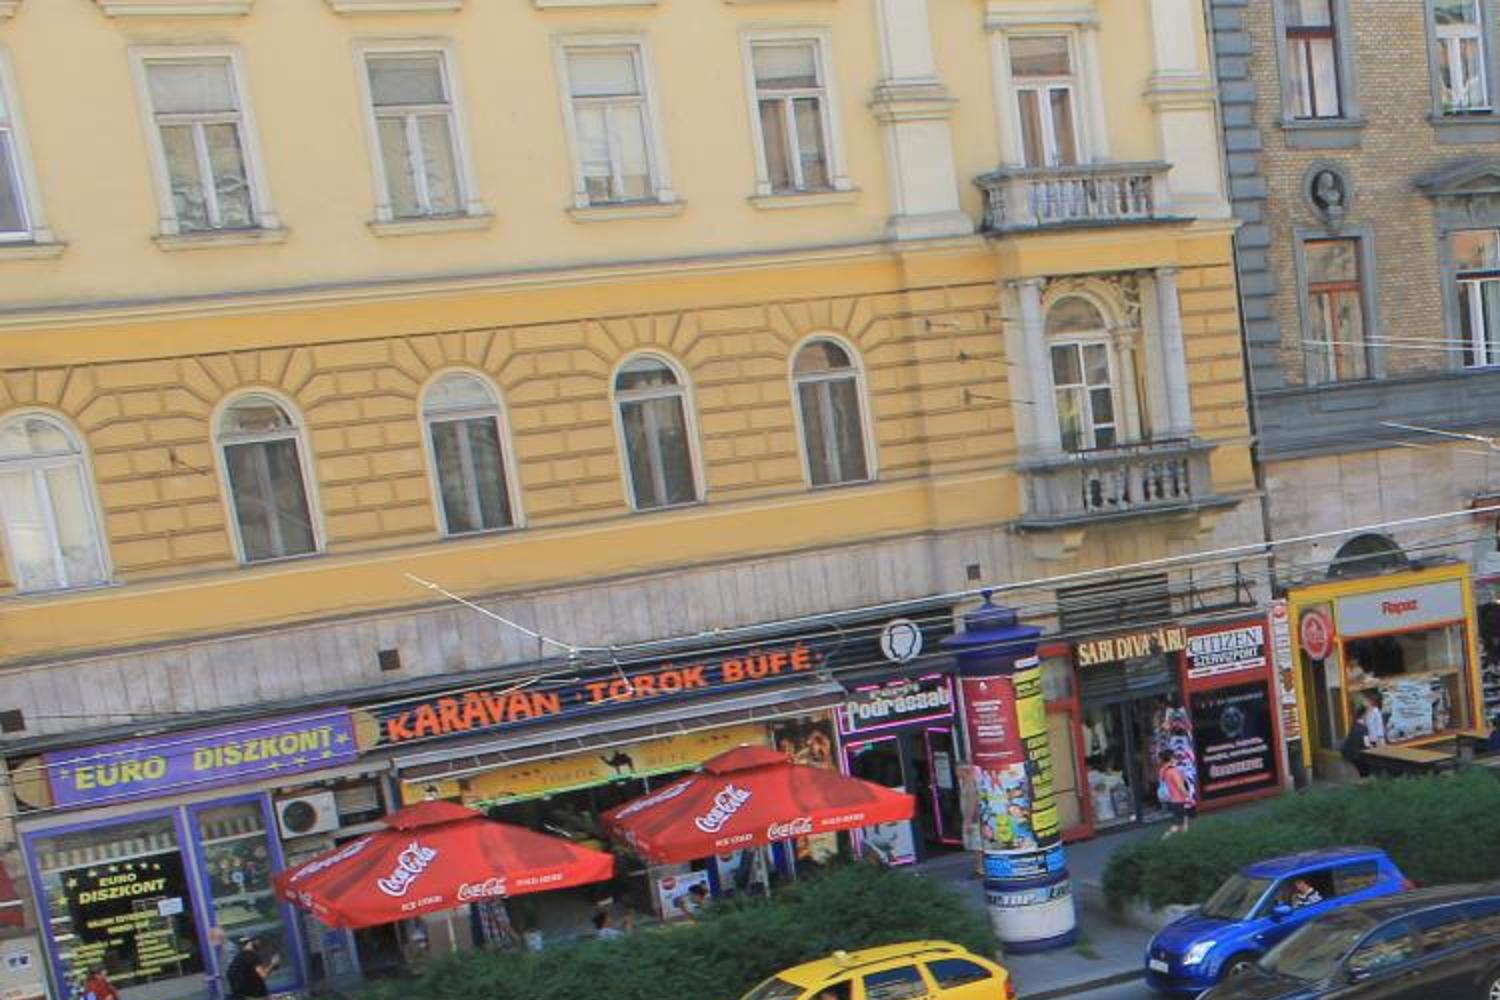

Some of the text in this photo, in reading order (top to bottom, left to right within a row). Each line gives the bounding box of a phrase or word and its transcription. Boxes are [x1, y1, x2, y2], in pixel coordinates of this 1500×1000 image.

[1078, 637, 1115, 667] SABI
[1190, 627, 1263, 654] CITIZEN
[585, 662, 708, 704] TÖRÖK
[721, 646, 812, 683] BÜFÉ
[75, 726, 334, 791] EURO DISZKONT
[79, 878, 167, 905] DISZKONT
[99, 873, 137, 887] EURO
